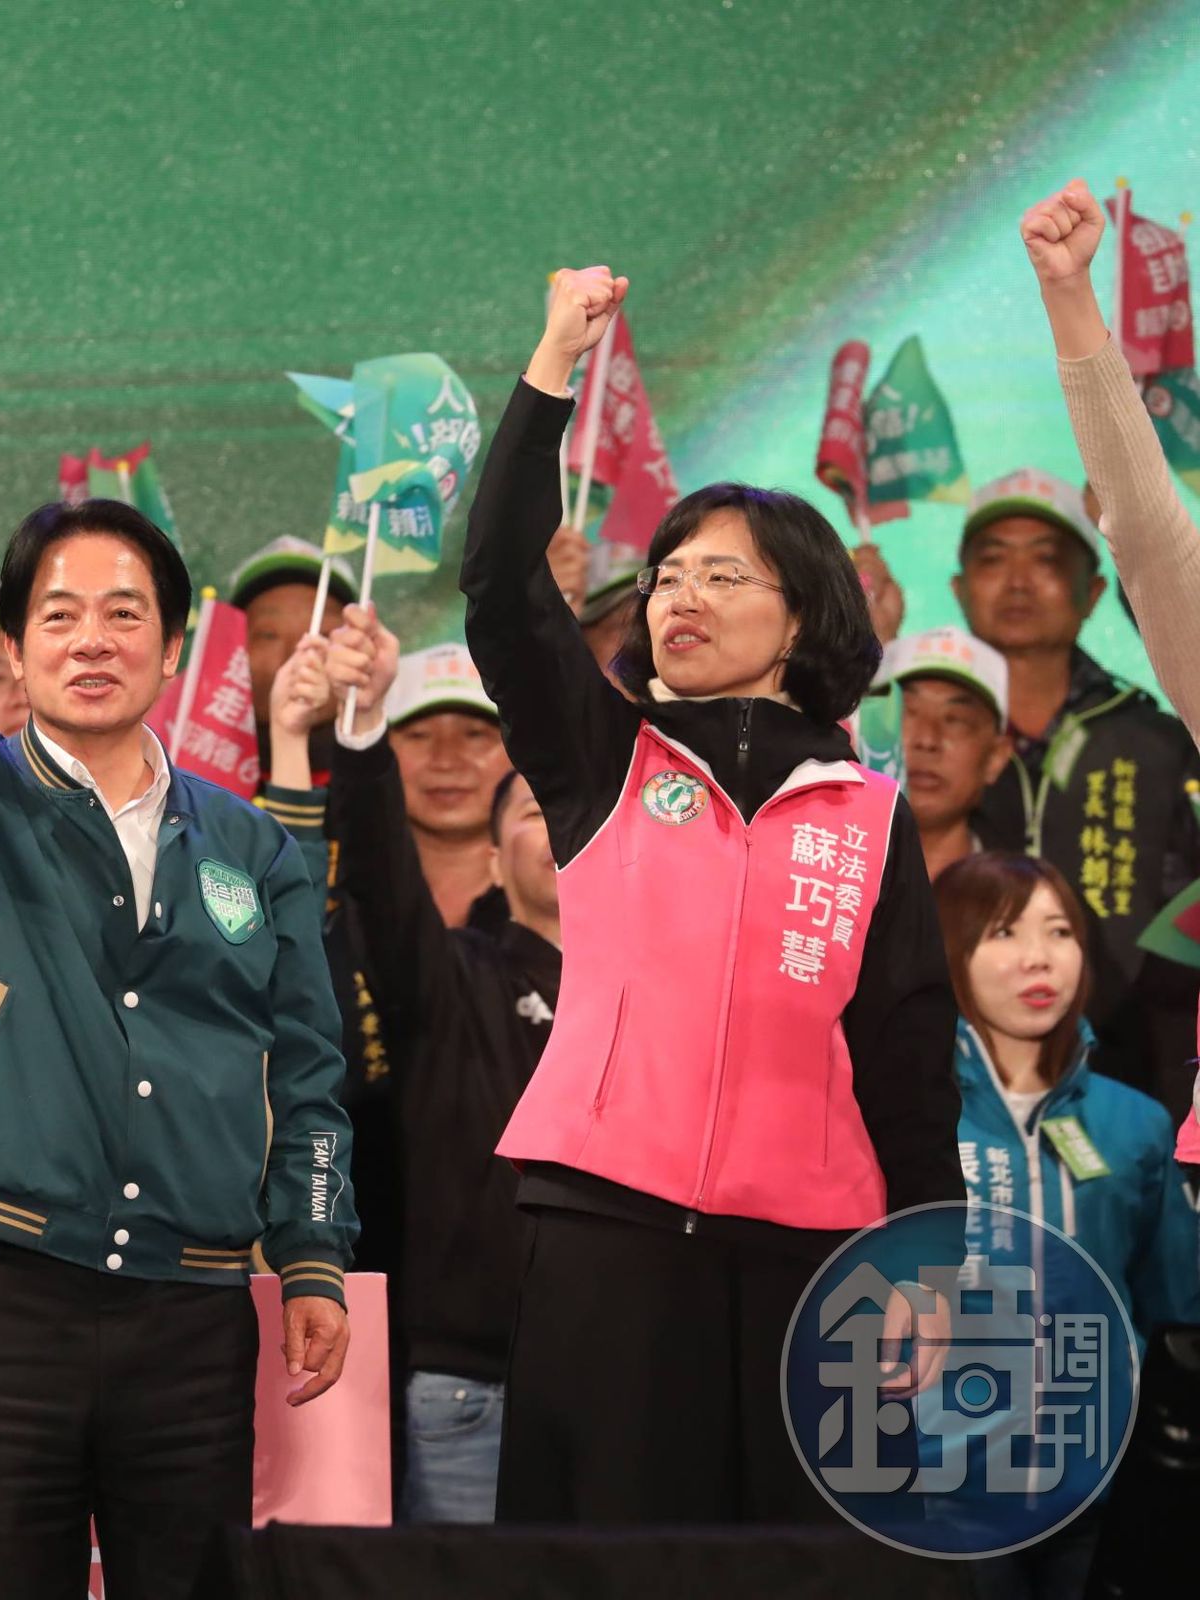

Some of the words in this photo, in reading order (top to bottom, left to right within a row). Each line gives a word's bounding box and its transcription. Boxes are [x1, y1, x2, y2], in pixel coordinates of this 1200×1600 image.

[779, 822, 839, 985] 蘇巧慧
[831, 823, 868, 950] 立法委員
[312, 1138, 329, 1168] TEAM
[311, 1173, 327, 1222] TAIWAN
